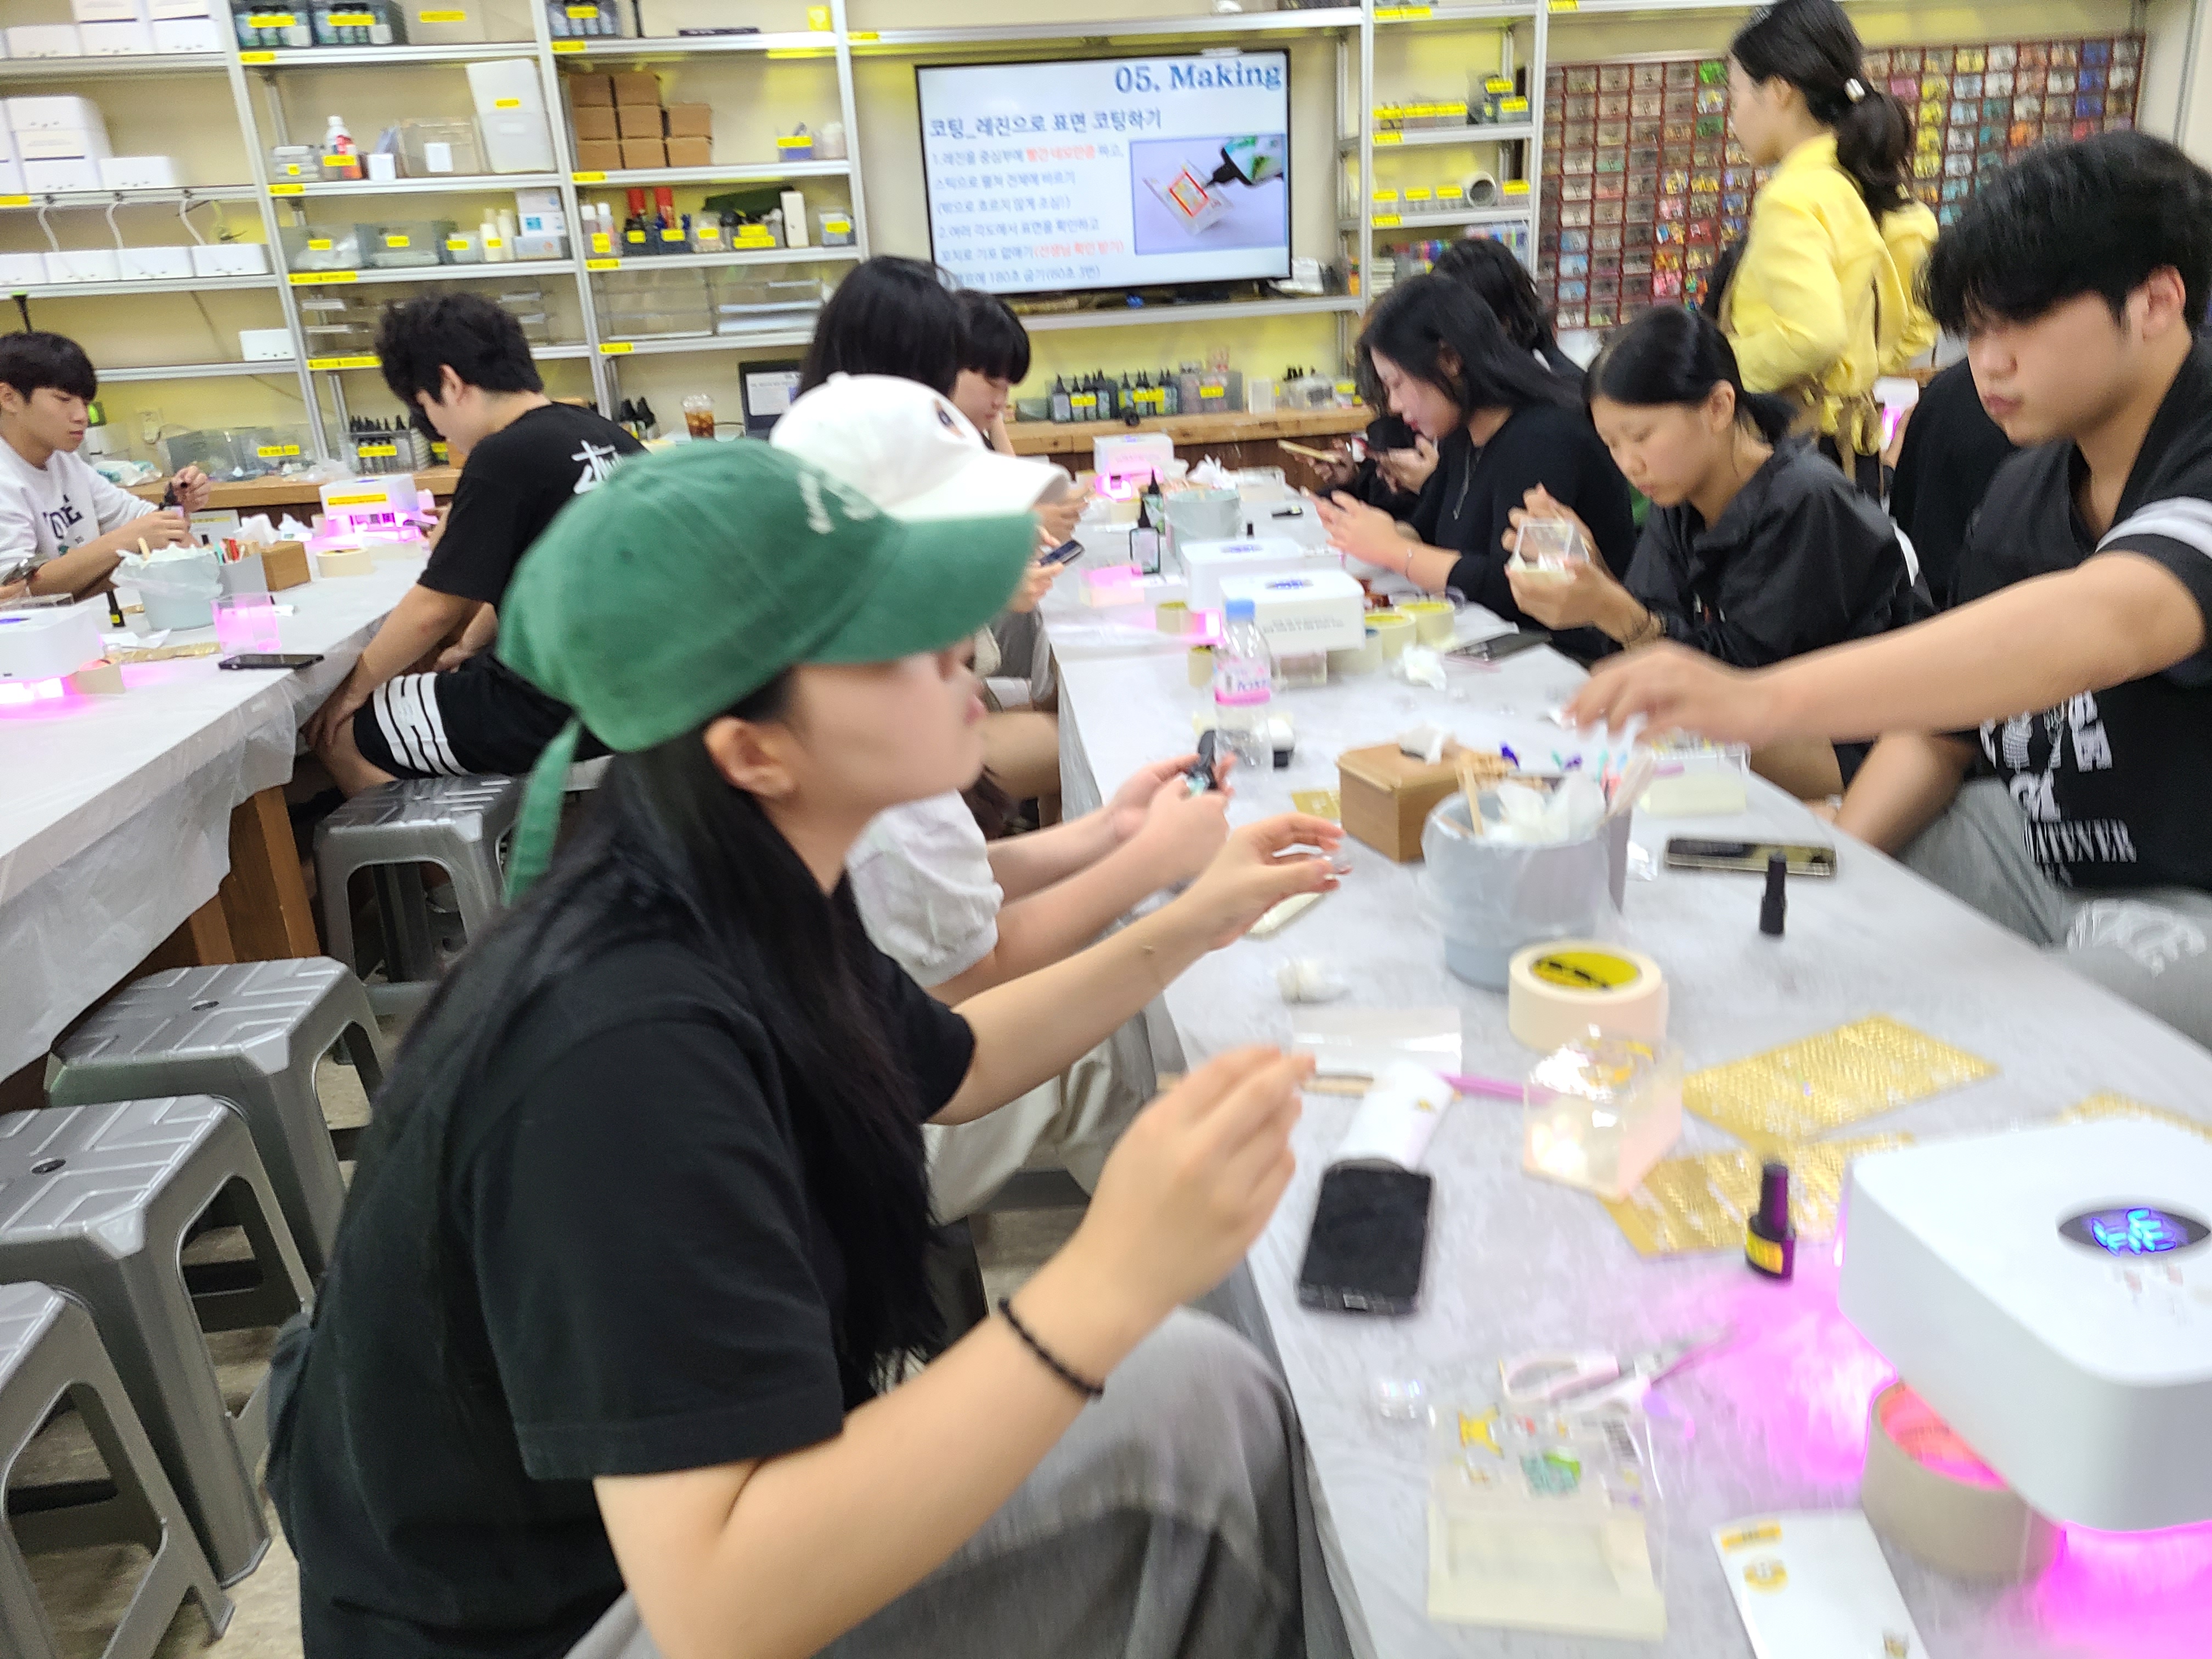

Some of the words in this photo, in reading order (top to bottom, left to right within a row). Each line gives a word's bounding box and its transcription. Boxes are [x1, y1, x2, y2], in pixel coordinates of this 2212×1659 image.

[1115, 65, 1161, 93] 05.
[1169, 59, 1282, 91] Making
[1053, 112, 1087, 133] 표면
[1093, 106, 1162, 132] 코팅하기
